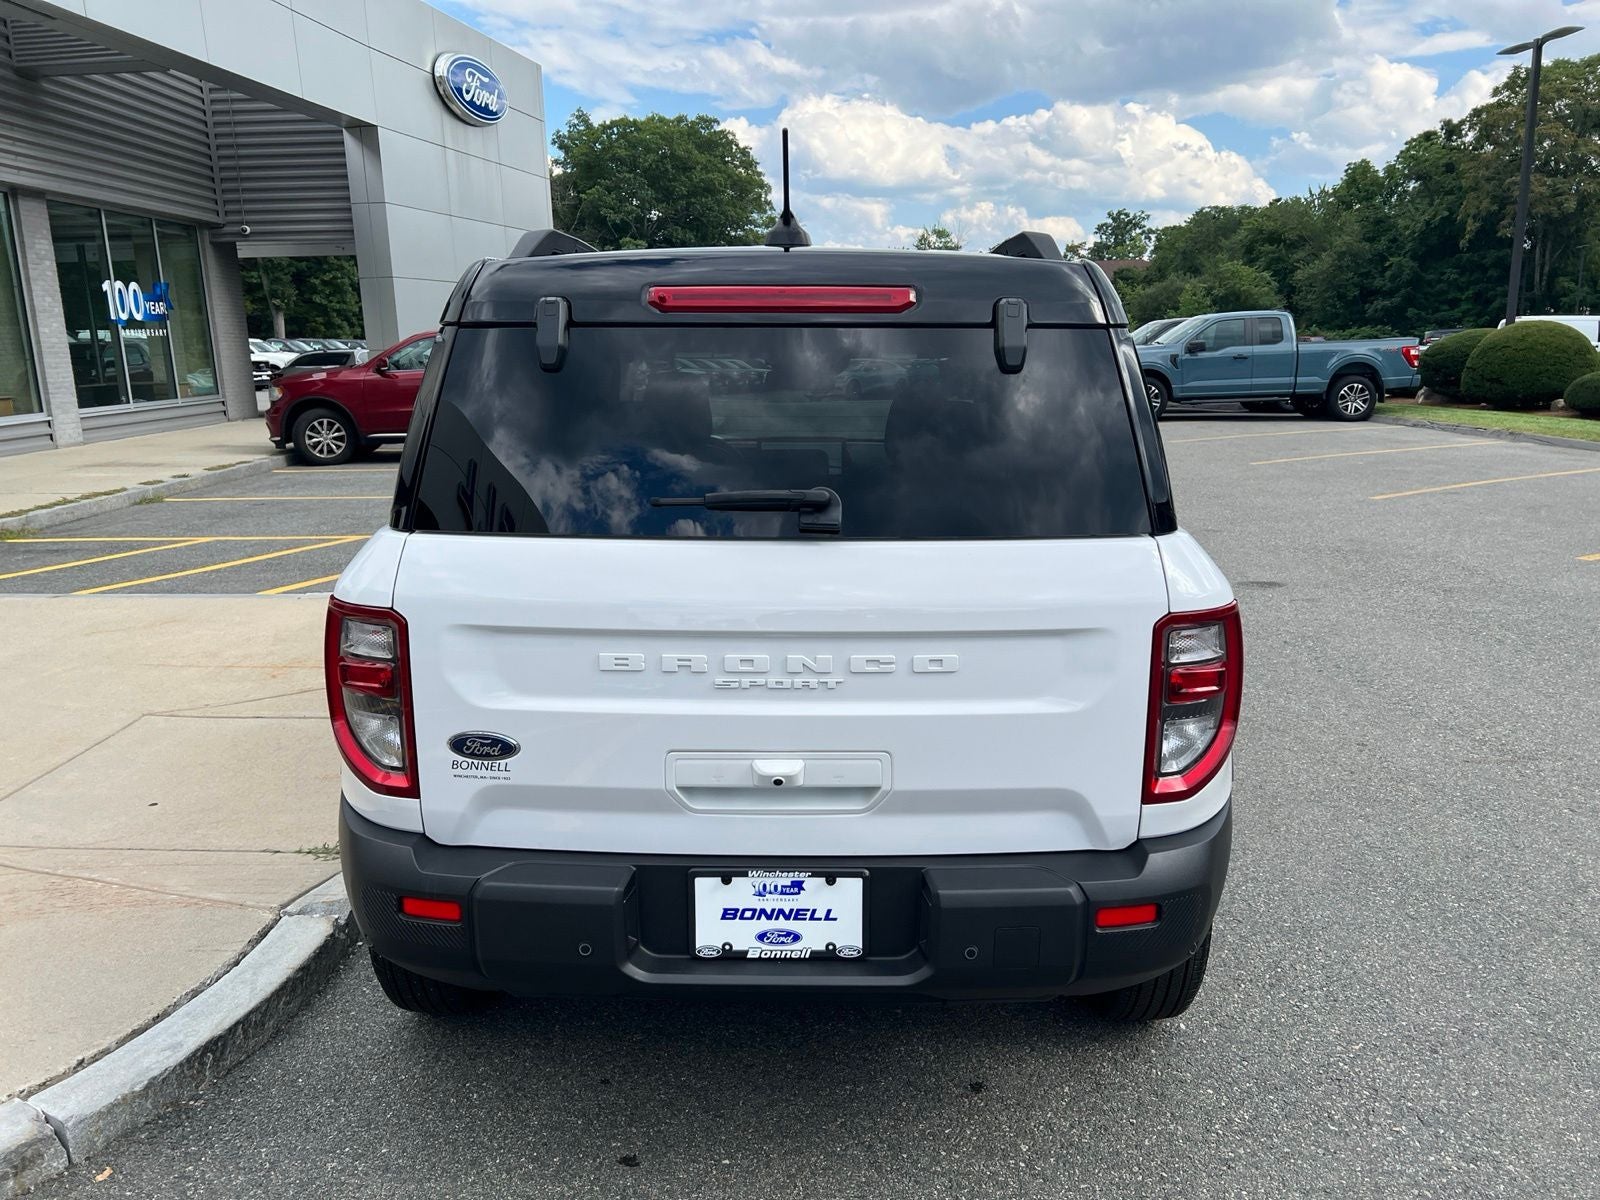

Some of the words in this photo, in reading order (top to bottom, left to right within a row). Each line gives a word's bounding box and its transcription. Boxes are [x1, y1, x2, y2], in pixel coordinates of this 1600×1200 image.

[462, 67, 499, 113] Ford
[101, 279, 145, 321] 100
[598, 652, 960, 674] BRONCO
[713, 678, 844, 690] SPORT
[462, 737, 502, 756] Ford
[451, 759, 511, 773] BONNELL
[748, 870, 812, 878] Winchester
[752, 880, 781, 896] 100
[720, 907, 838, 922] BONNELL
[763, 931, 794, 944] Ford
[746, 947, 812, 959] Bonnell
